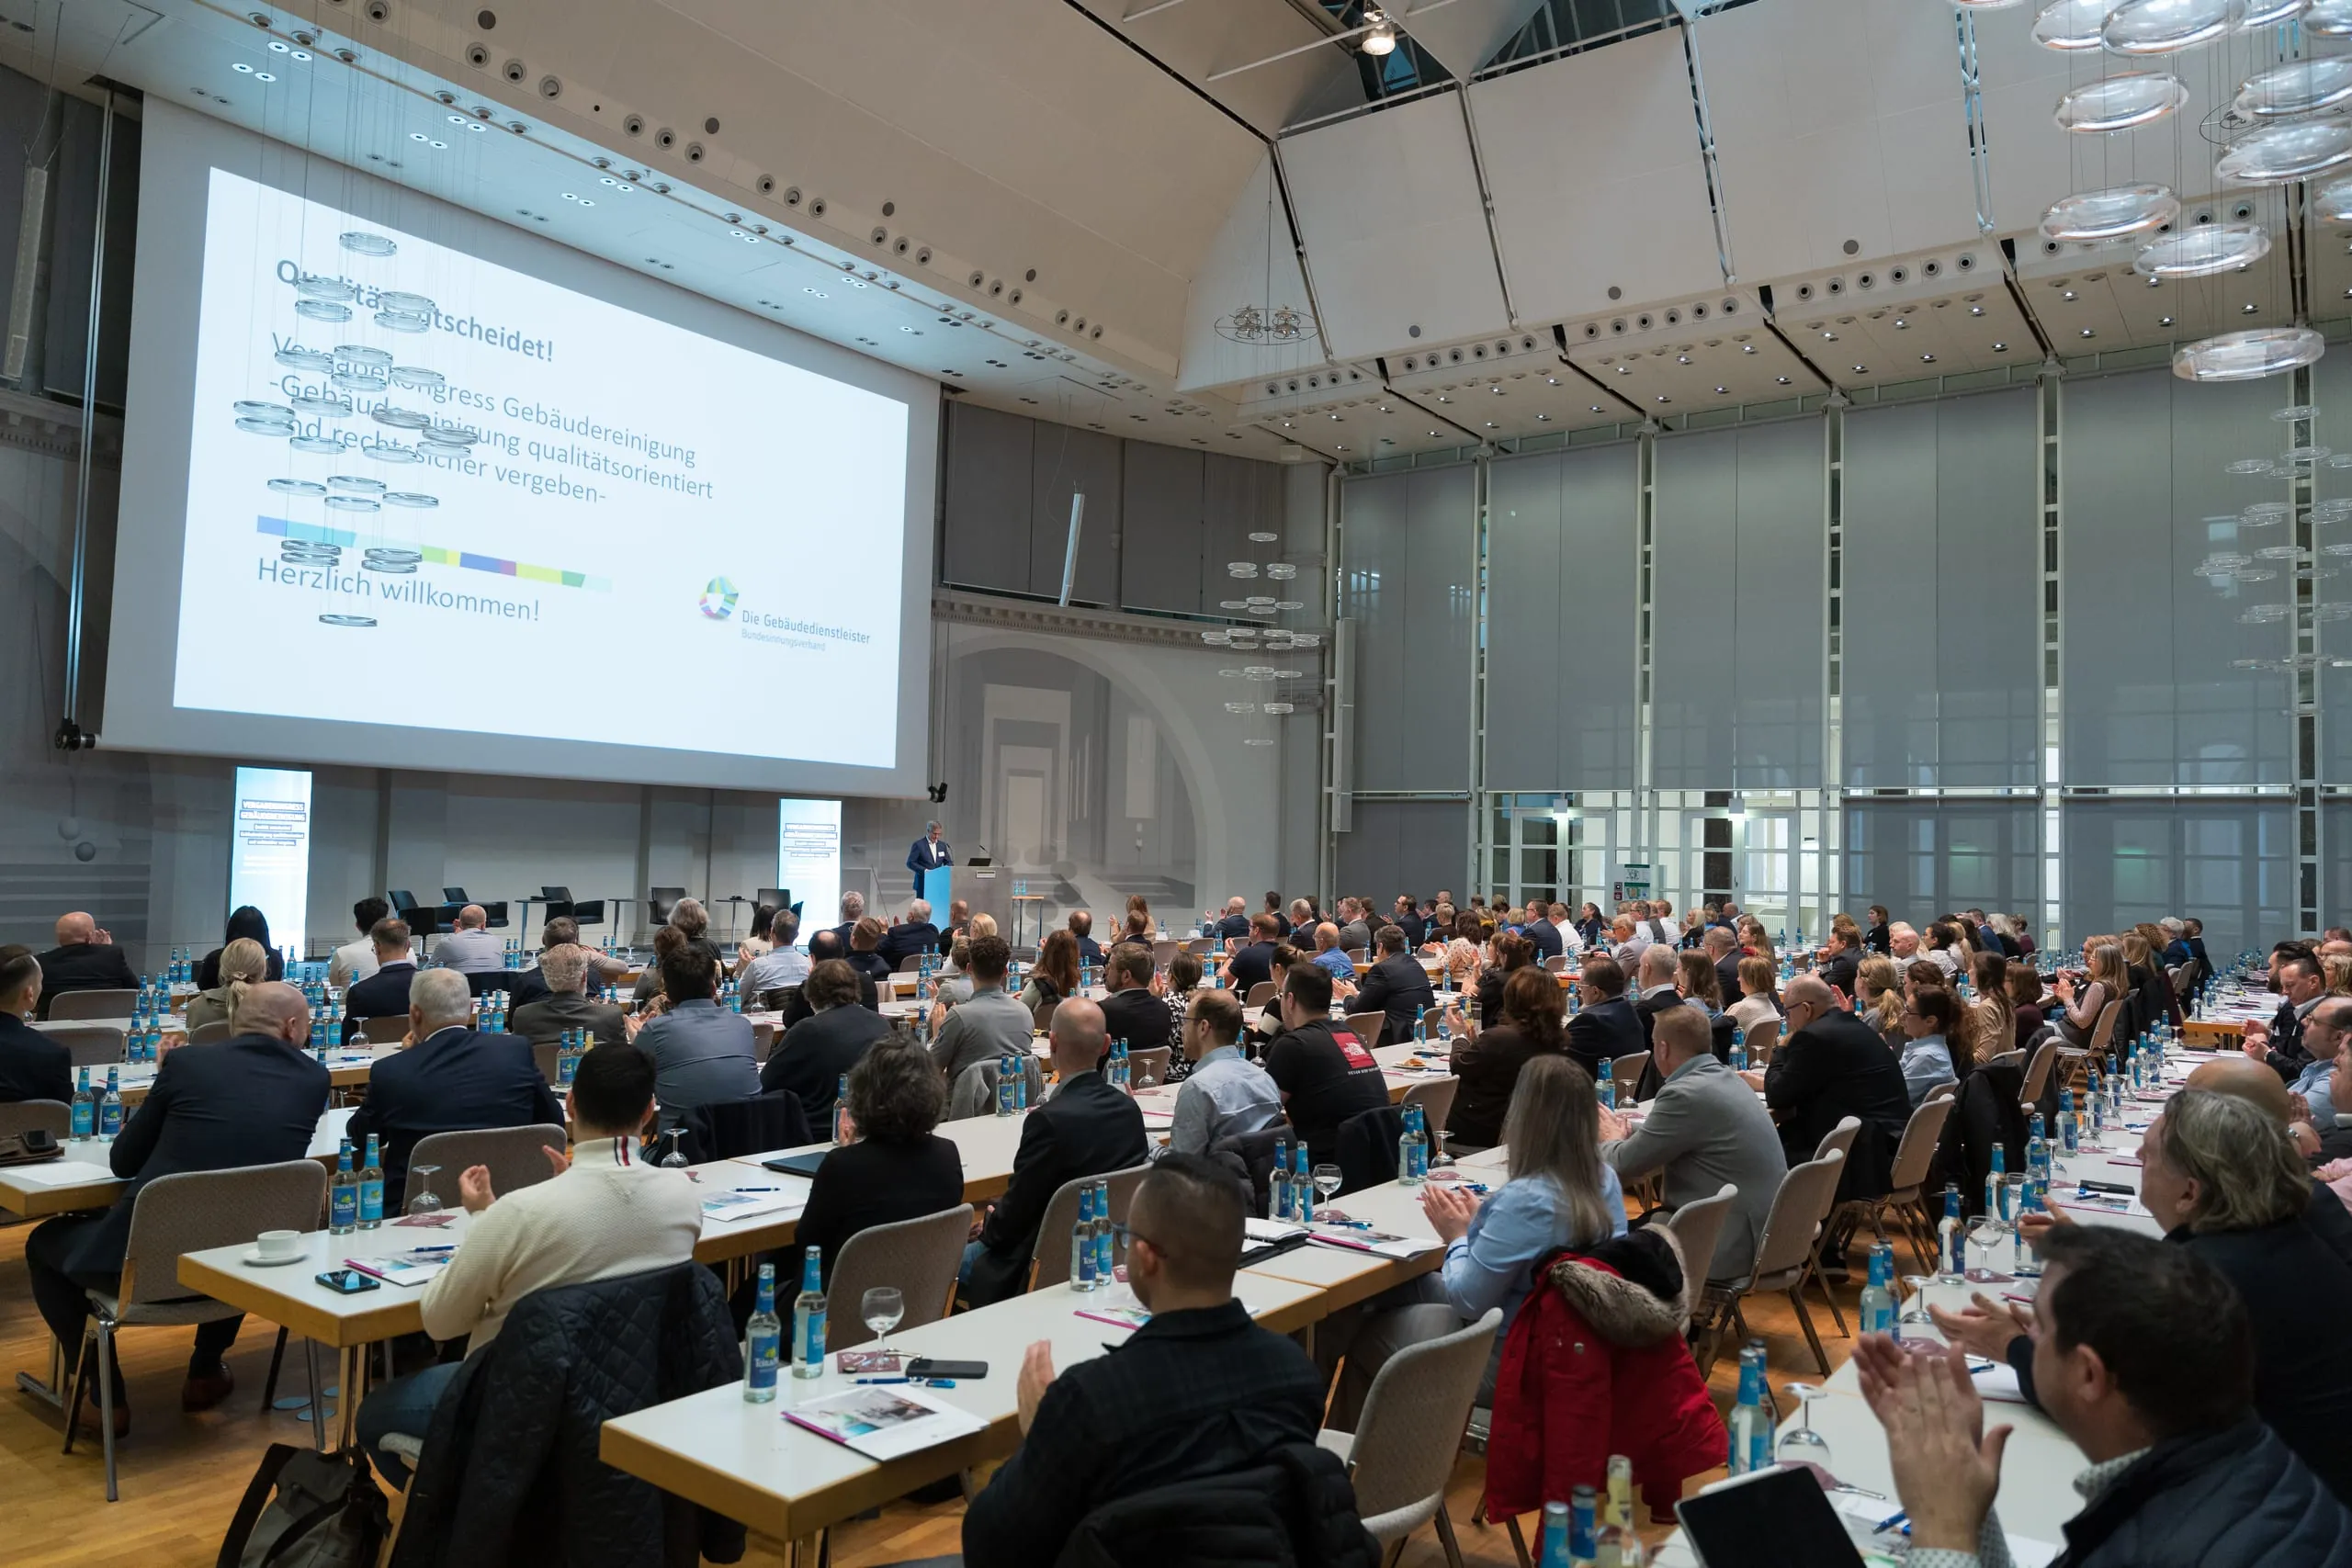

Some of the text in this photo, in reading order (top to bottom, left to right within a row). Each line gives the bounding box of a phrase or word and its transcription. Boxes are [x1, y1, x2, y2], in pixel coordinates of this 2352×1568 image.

[383, 306, 553, 363] tscheidet!
[270, 375, 713, 499] -Gebäudiniung qualitätsorientiert
[288, 417, 322, 439] nd
[494, 464, 606, 503] vergeben-
[503, 397, 695, 468] Gebäudereinigung
[258, 558, 539, 622] Herzlich willkommen!
[742, 610, 871, 644] Die Gebäudedienstleister
